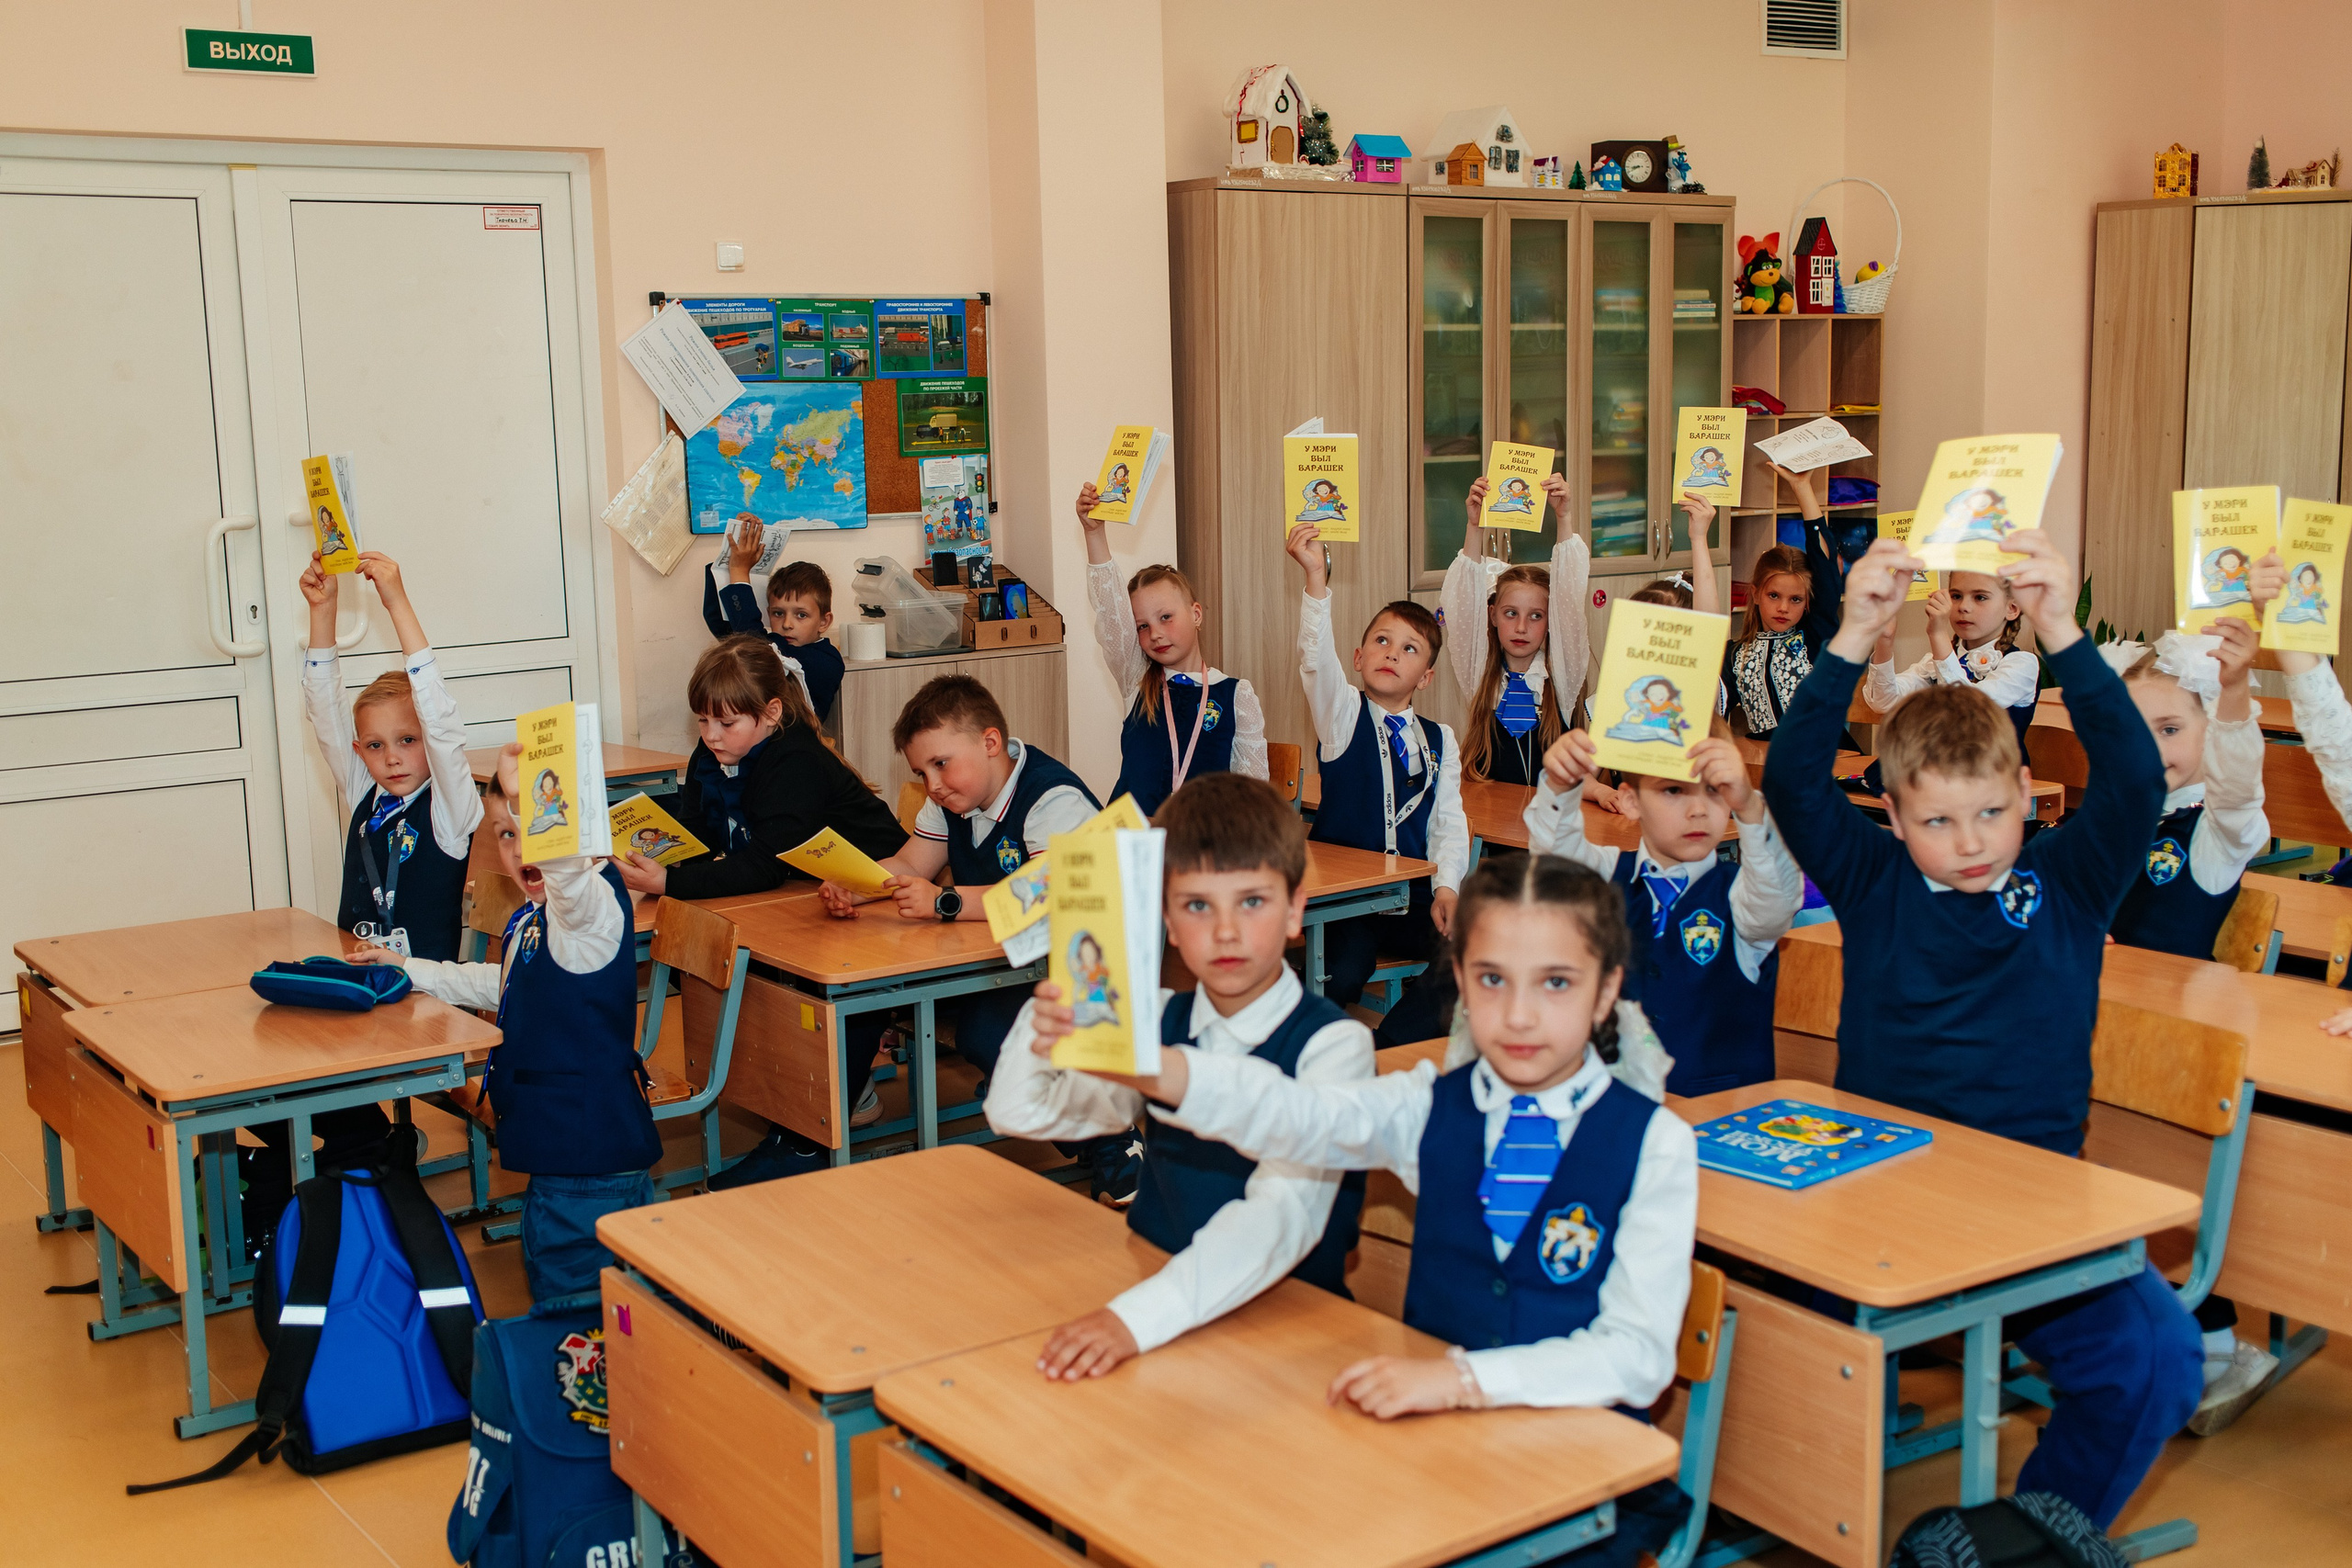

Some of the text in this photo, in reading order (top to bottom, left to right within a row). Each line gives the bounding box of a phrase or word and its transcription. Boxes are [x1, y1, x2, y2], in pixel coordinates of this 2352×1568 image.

[209, 41, 292, 66] ВЫХОД
[1515, 450, 1535, 458] МЭРИ
[1979, 445, 2020, 454] МЭРИ
[1499, 464, 1538, 475] БАРАШЕК
[2203, 499, 2247, 509] У МЭРИ
[2211, 513, 2240, 523] БЫЛ
[2311, 513, 2335, 525] МЭРИ
[2194, 525, 2258, 537] БАРАШЕК
[1643, 619, 1693, 636] У МЭРИ
[1649, 636, 1681, 649] БЫЛ
[1627, 648, 1697, 668] БАРАШЕК
[532, 717, 557, 732] У МЭРИ
[537, 733, 553, 745] БЫЛ
[528, 744, 564, 761] БАРАШЕК
[611, 807, 634, 820] МЭРИ
[612, 814, 653, 837] БАРАШЕК
[616, 814, 636, 826] БЫЛ
